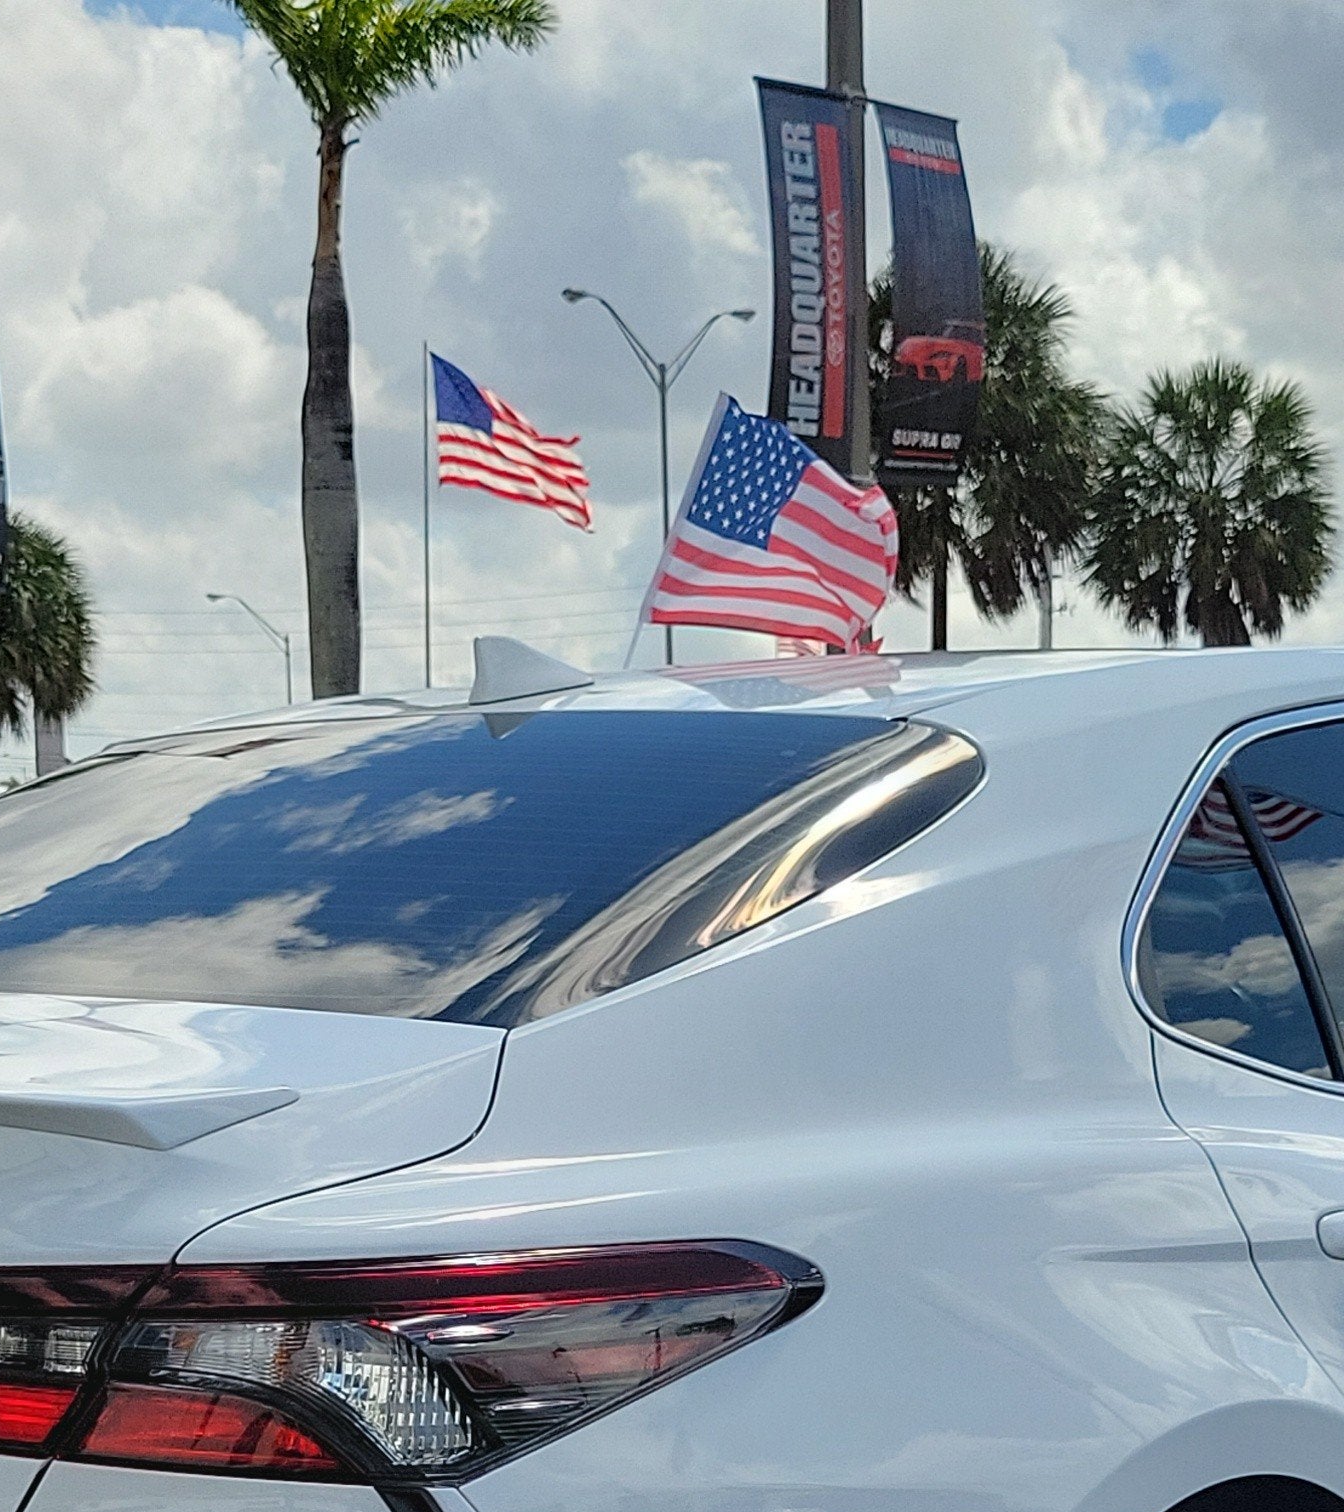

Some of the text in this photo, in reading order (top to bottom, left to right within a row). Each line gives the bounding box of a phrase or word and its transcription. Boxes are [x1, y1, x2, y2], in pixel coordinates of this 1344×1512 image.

[781, 120, 825, 438] HEADQUARTER
[825, 209, 845, 328] TOYOTA
[892, 428, 939, 448] SUPRA
